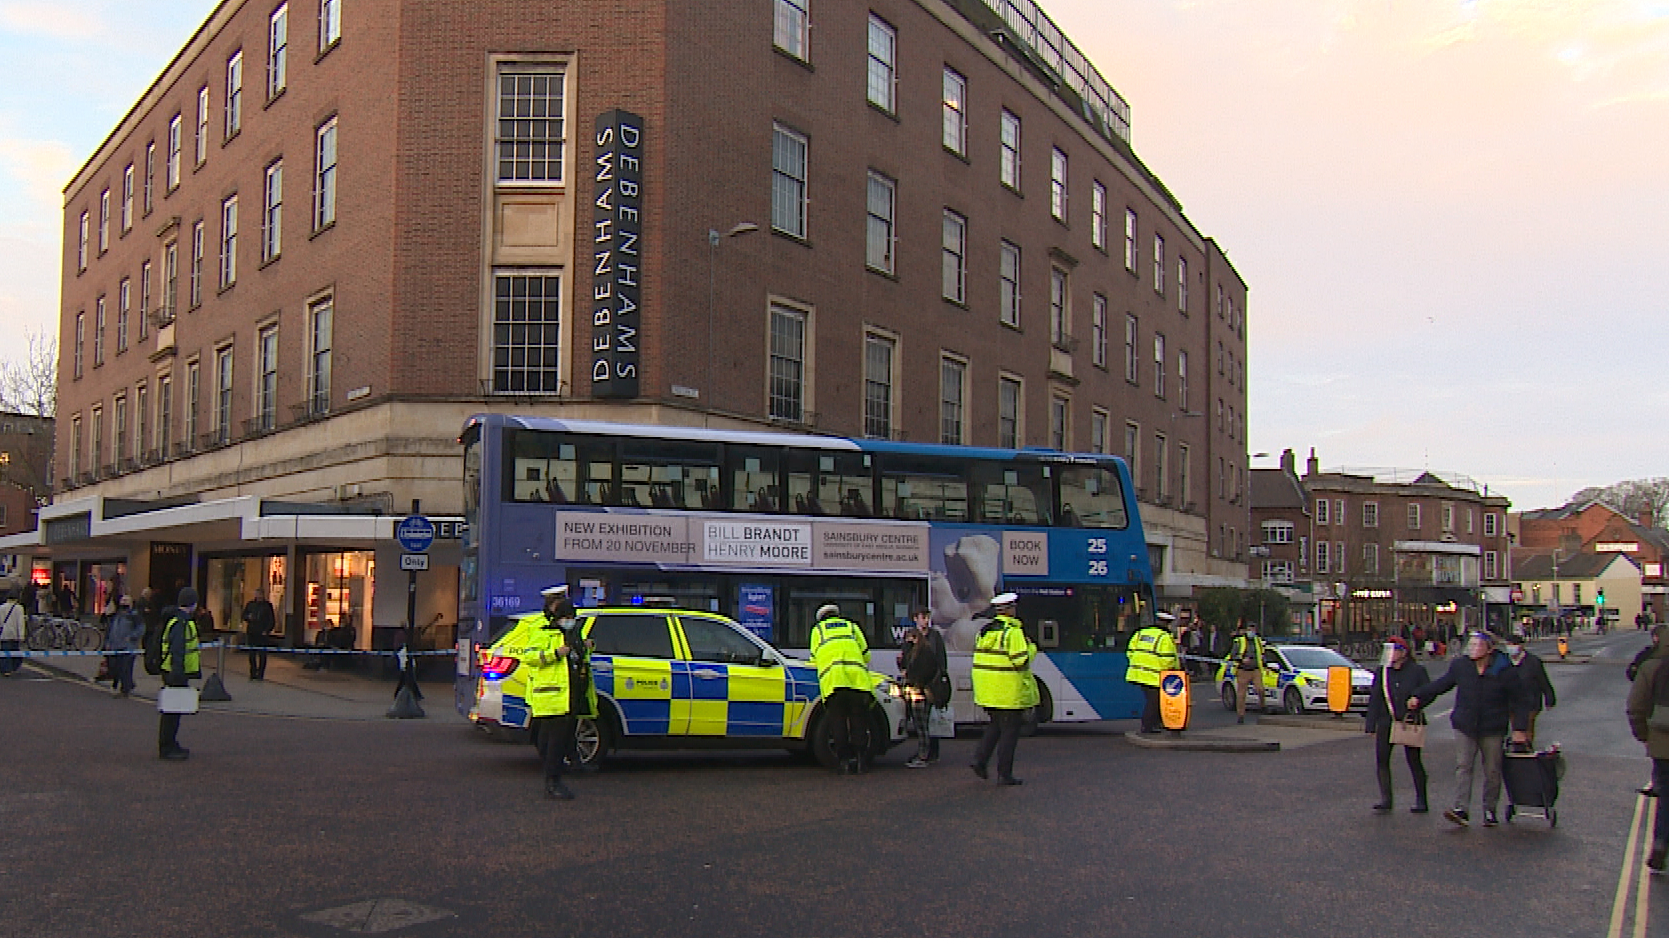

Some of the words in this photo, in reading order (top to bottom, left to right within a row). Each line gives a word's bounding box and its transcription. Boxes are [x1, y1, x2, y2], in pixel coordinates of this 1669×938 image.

[593, 126, 614, 381] DEBENHAMS
[616, 124, 640, 379] DEBENHAMS
[564, 522, 595, 534] NEW
[599, 523, 671, 537] EXHIBITION
[708, 526, 739, 539] BILL
[744, 526, 800, 542] BRANDT
[823, 532, 878, 543] SAINSBURY
[564, 538, 602, 550] FROM
[606, 540, 621, 552] 20
[624, 540, 696, 554] NOVEMBER
[708, 544, 755, 557] HENRY
[760, 545, 808, 560] MOORE
[1010, 540, 1042, 551] BOOK
[1087, 538, 1107, 553] 25
[404, 556, 425, 568] Only
[823, 550, 919, 562] sainsburycentre.ac.uk
[1012, 554, 1039, 566] NOW
[1088, 560, 1108, 575] 26
[493, 597, 520, 608] 36169
